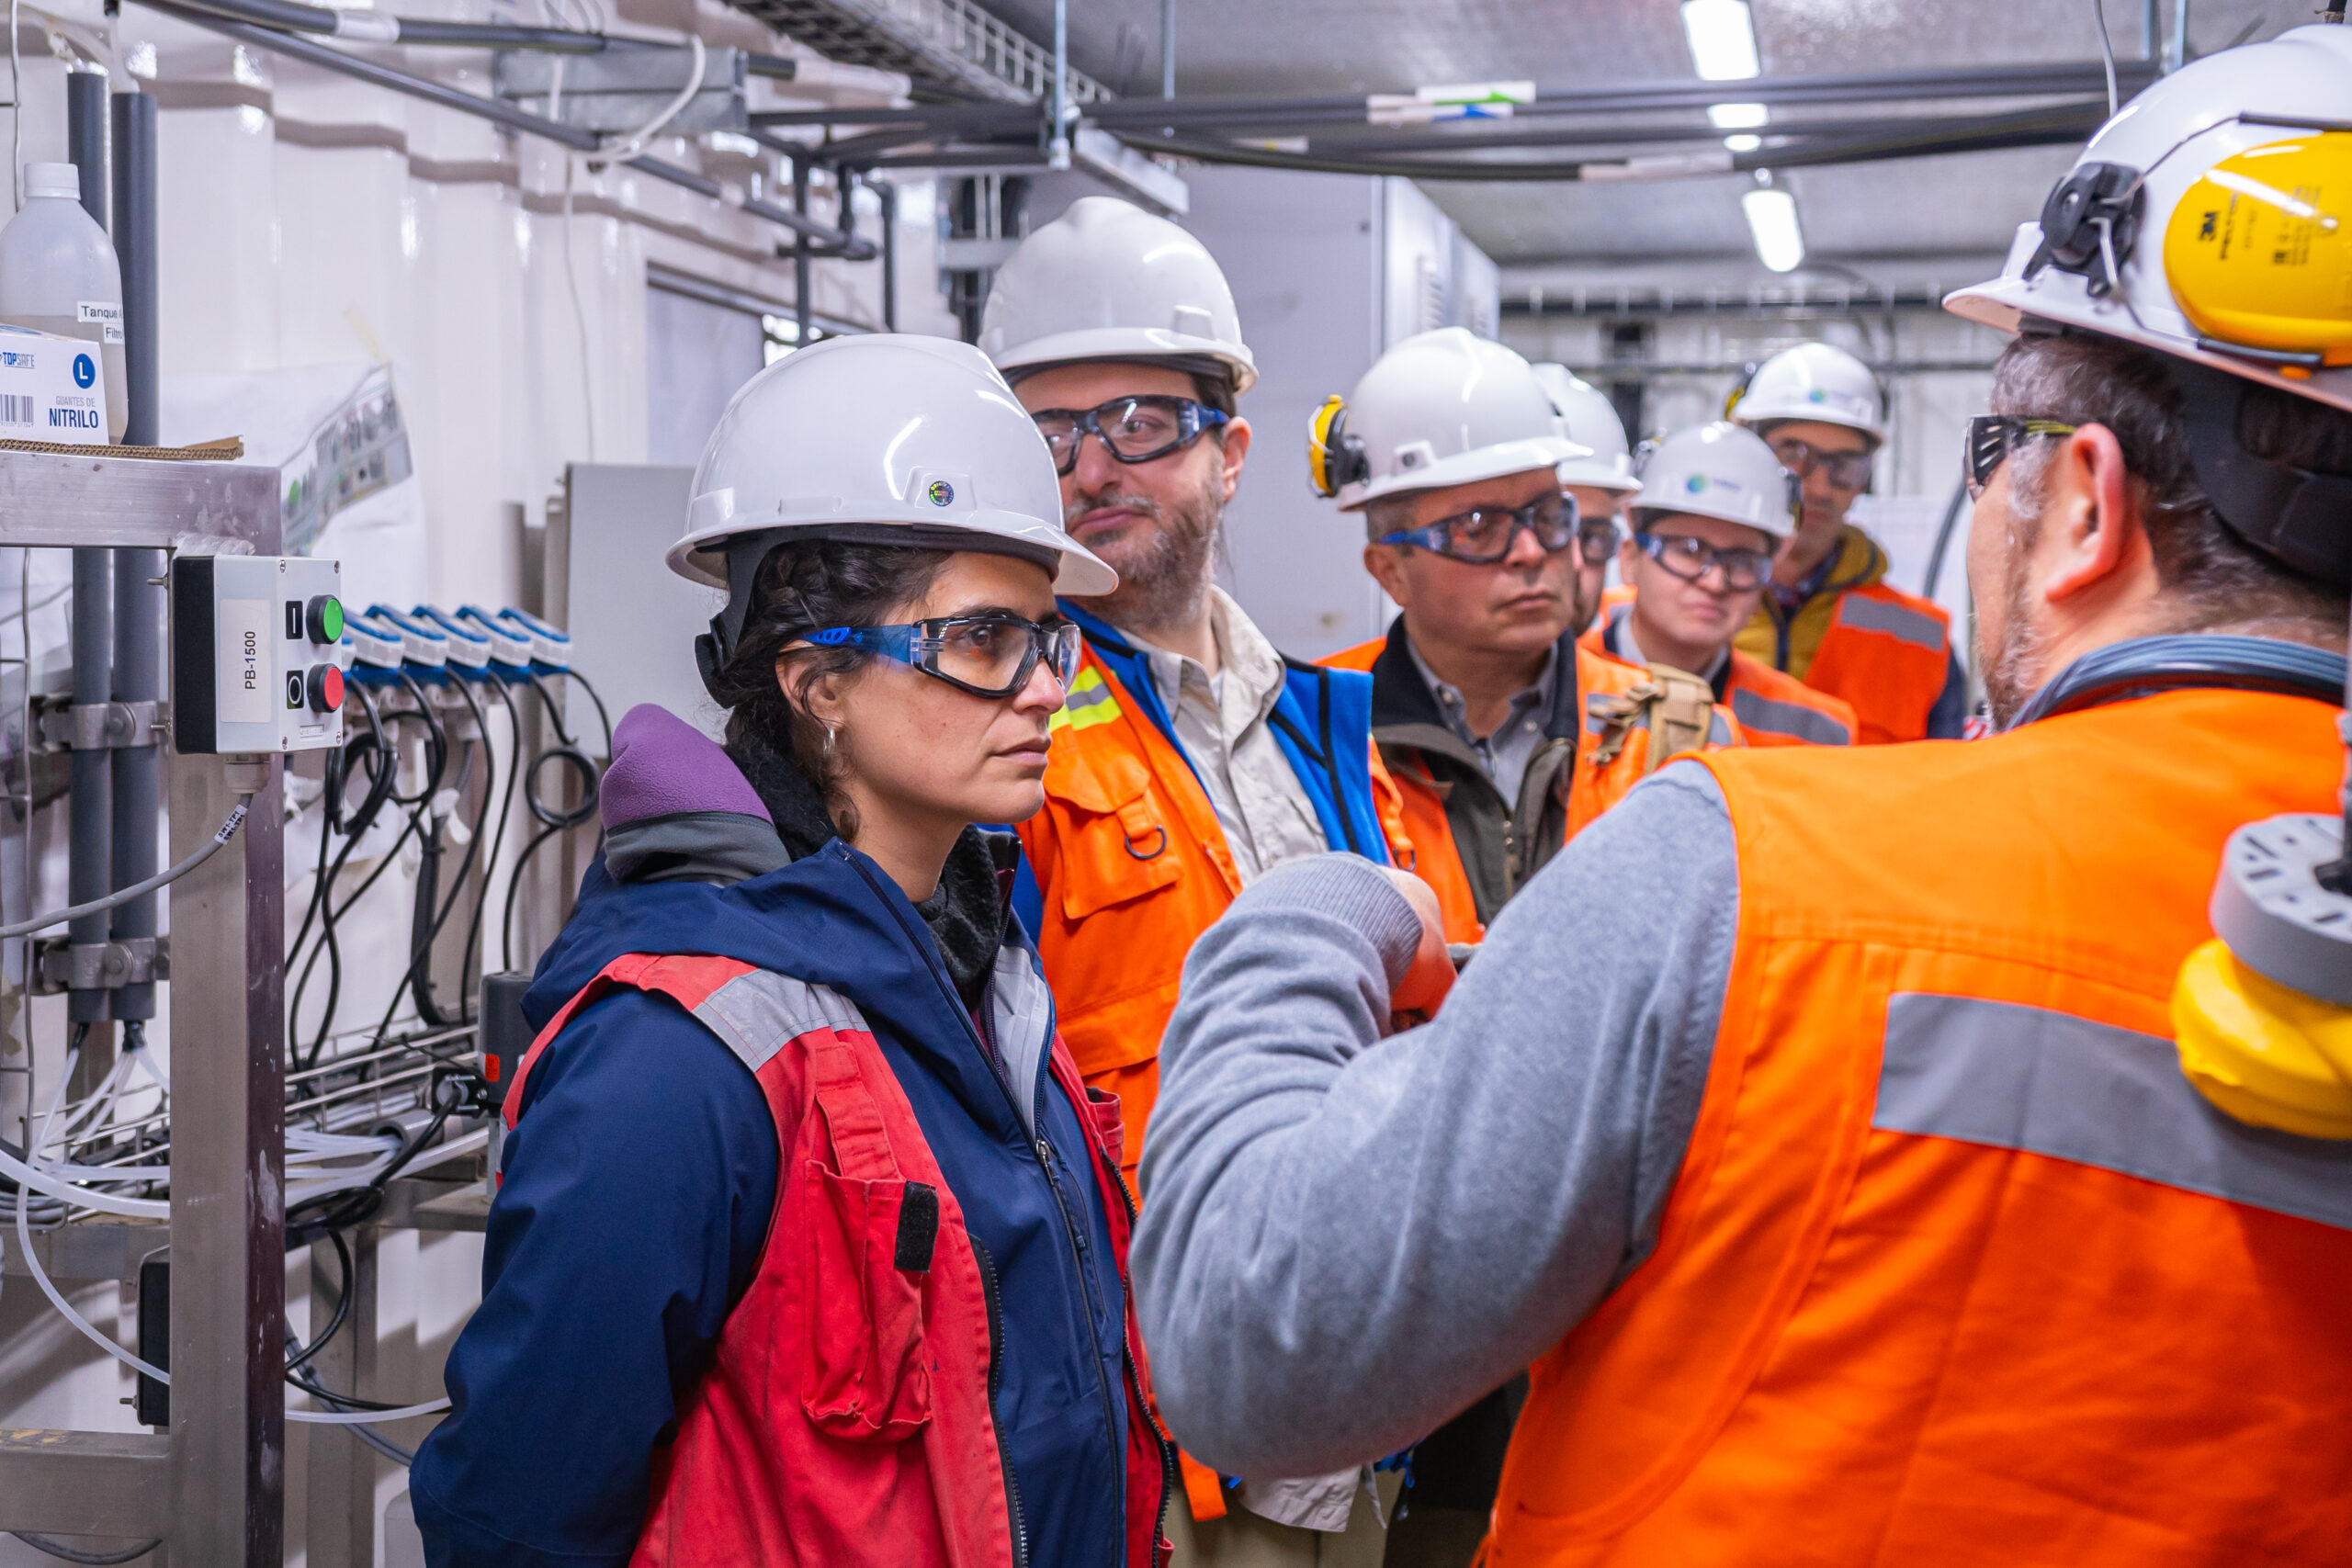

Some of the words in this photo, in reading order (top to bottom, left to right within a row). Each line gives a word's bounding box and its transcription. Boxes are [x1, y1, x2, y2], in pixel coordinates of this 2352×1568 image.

[2199, 211, 2219, 242] 3M
[81, 305, 118, 320] Tanque
[3, 352, 35, 367] TOPSAFE
[79, 361, 89, 379] L
[55, 395, 85, 407] GUANTES
[85, 397, 96, 407] DE
[49, 408, 99, 429] NITRILO
[244, 631, 256, 690] PB-1500
